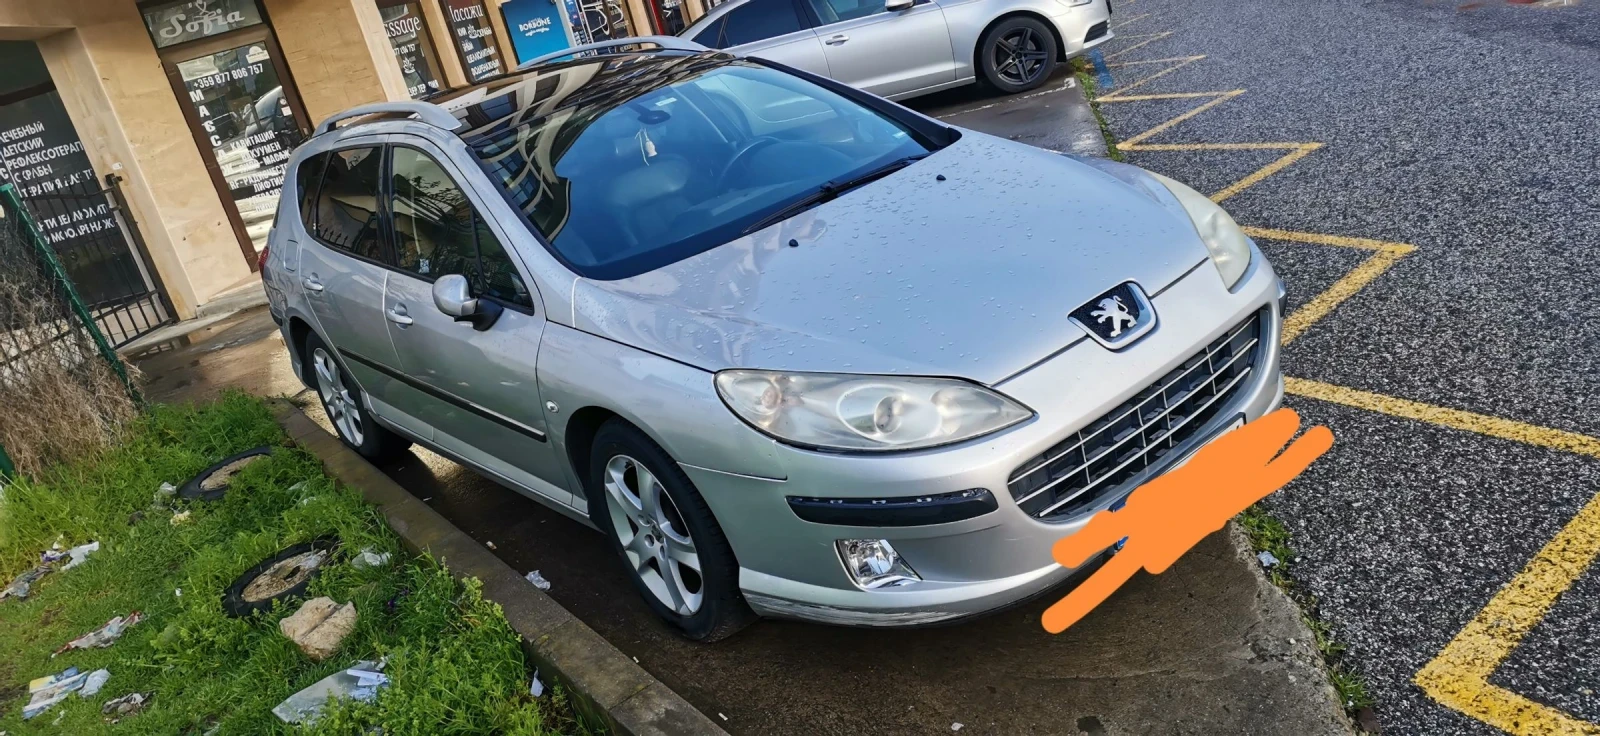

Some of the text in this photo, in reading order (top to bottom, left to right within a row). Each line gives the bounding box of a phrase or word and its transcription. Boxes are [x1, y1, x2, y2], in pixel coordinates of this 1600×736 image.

[160, 8, 245, 38] Sofia
[384, 16, 421, 38] assage
[519, 17, 551, 32] BORBONE
[193, 63, 264, 88] +359 877 806 757
[3, 137, 45, 158] ДЕТСКИЙ
